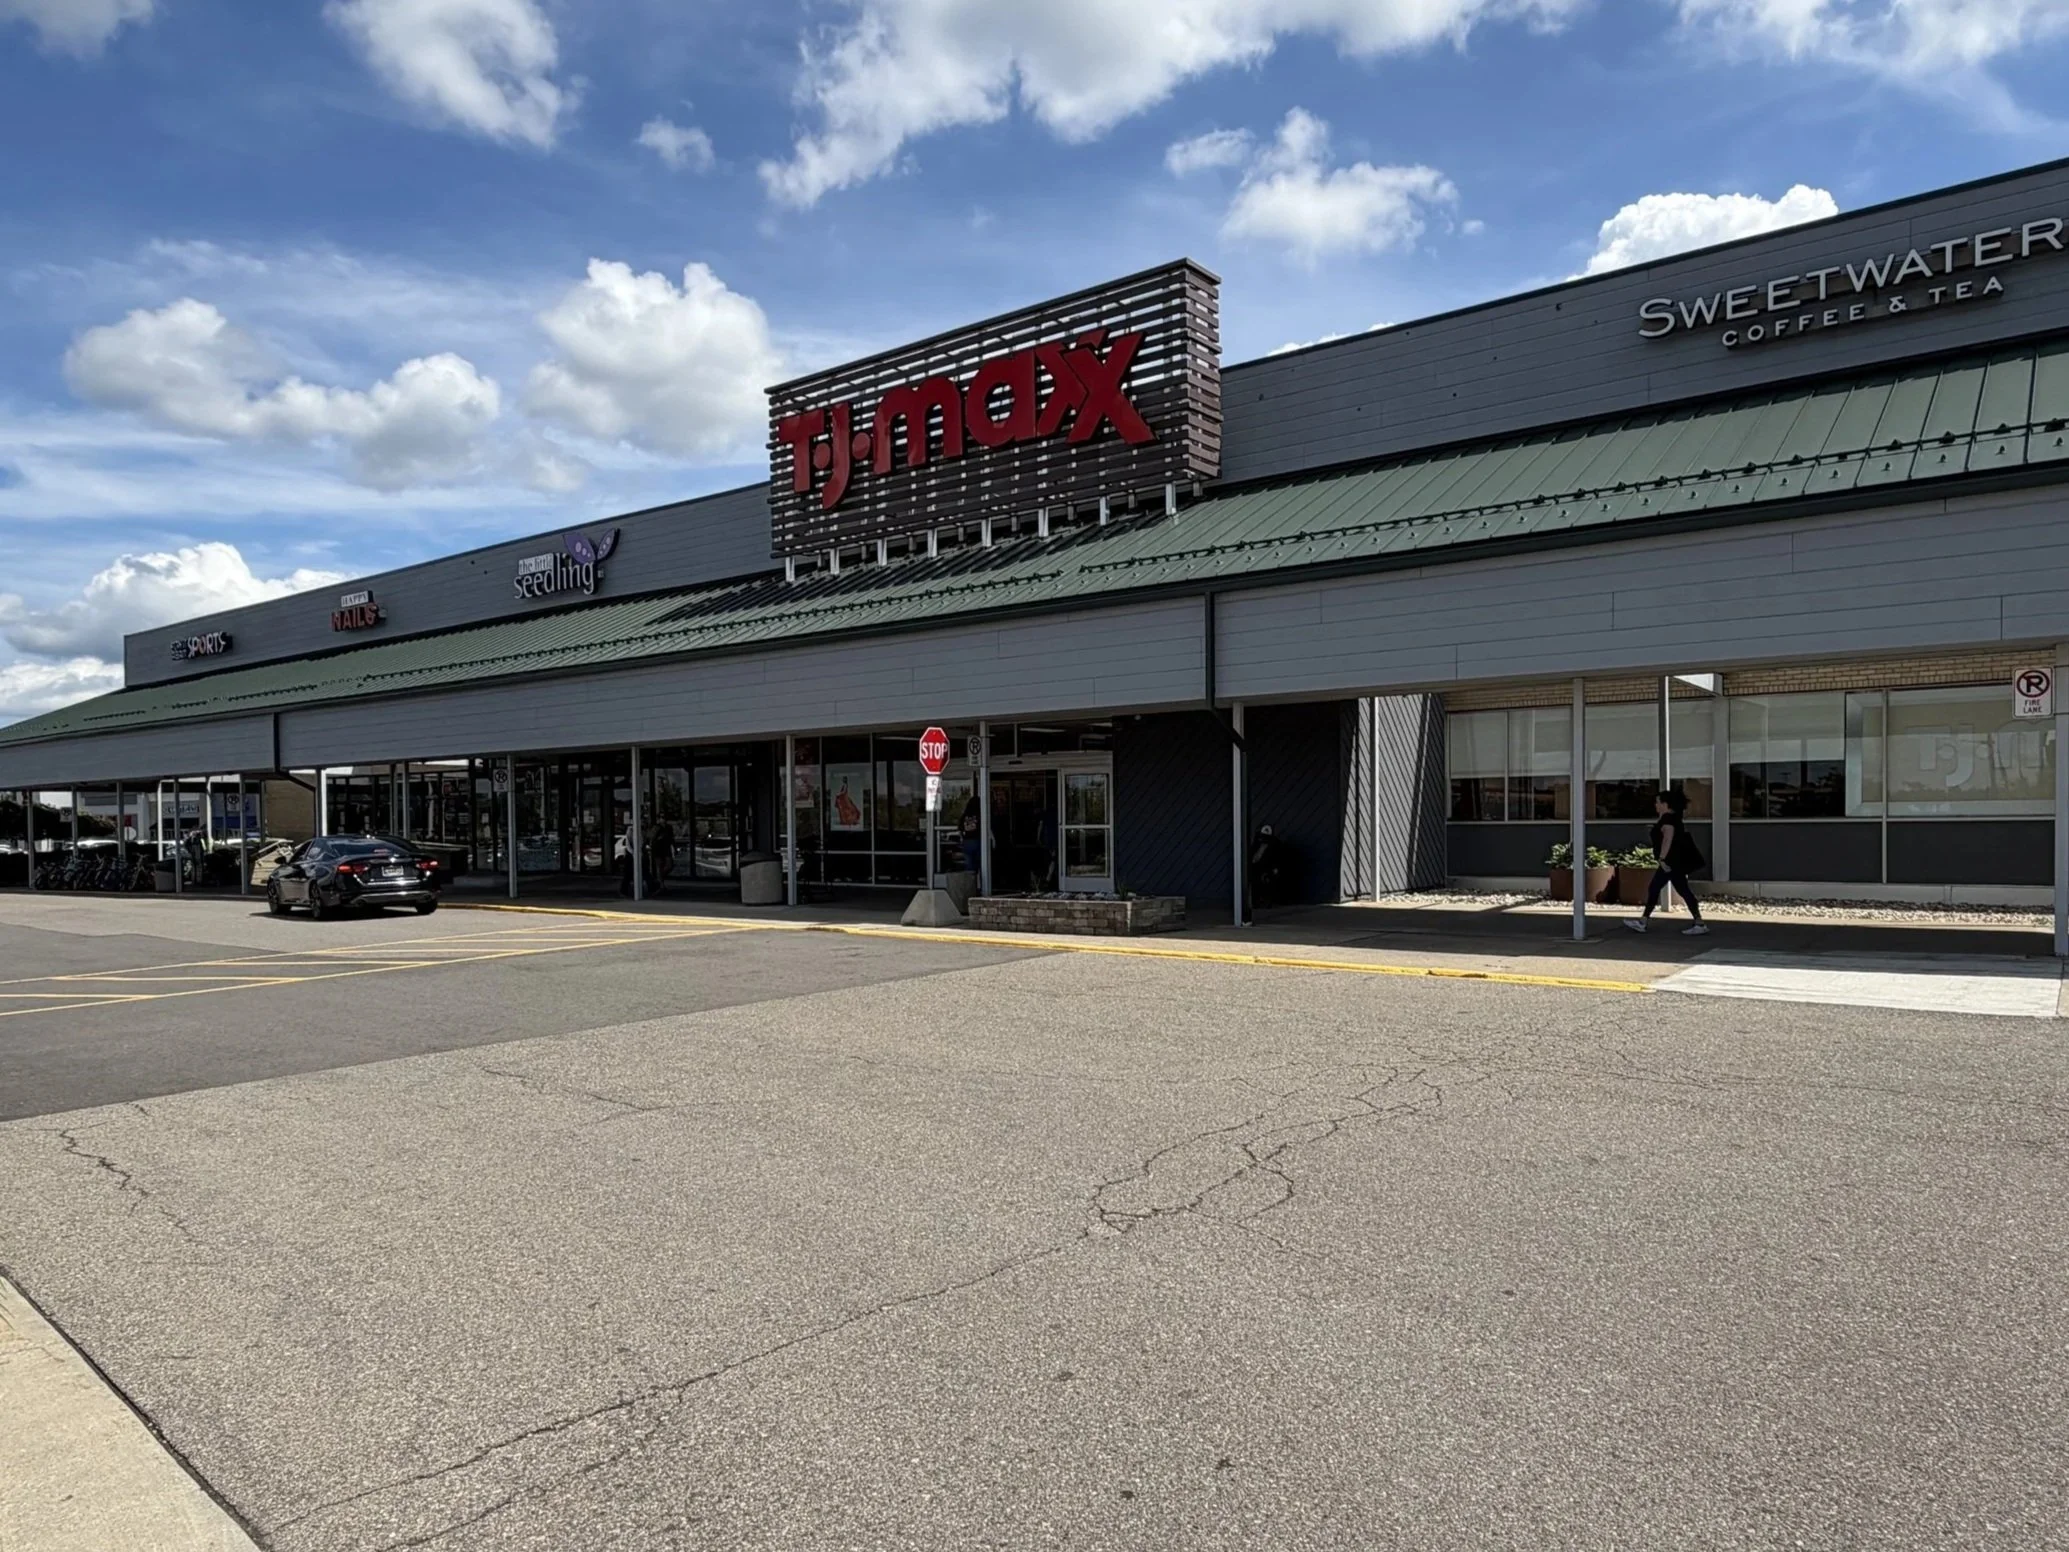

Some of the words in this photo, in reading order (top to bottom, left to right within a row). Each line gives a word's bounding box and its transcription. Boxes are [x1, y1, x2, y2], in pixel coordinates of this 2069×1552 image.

[1638, 217, 2065, 338] SWEETWATER
[1722, 303, 1865, 348] COFFEE
[1888, 295, 1908, 314] &
[1928, 276, 2004, 305] TEA
[513, 553, 595, 599] seedling
[330, 602, 377, 631] NAILS
[187, 631, 226, 658] SPORTS
[2023, 706, 2042, 714] LANE
[921, 742, 948, 760] STOP
